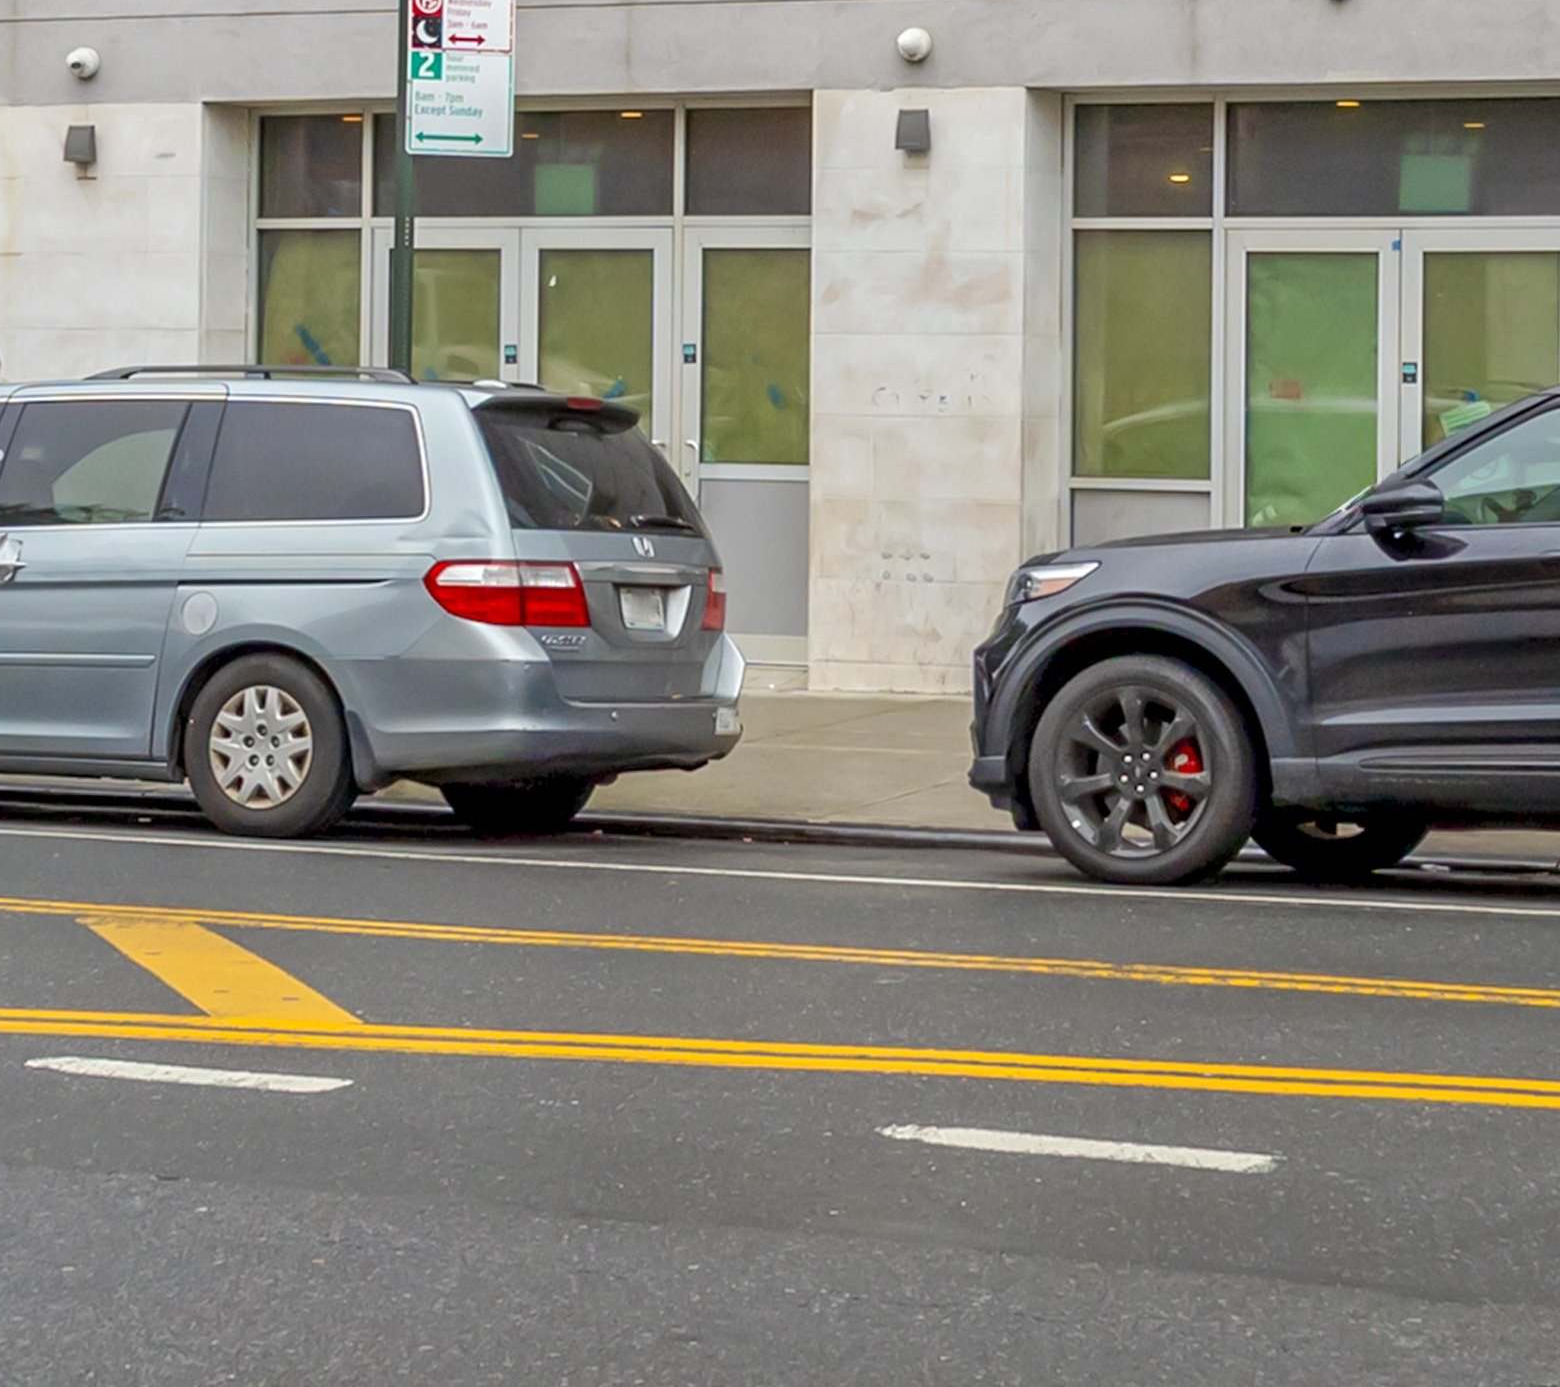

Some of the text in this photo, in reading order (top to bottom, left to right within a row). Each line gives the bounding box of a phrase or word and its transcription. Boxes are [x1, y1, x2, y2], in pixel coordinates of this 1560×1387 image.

[418, 51, 435, 78] 2
[415, 104, 483, 118] Except Sunday
